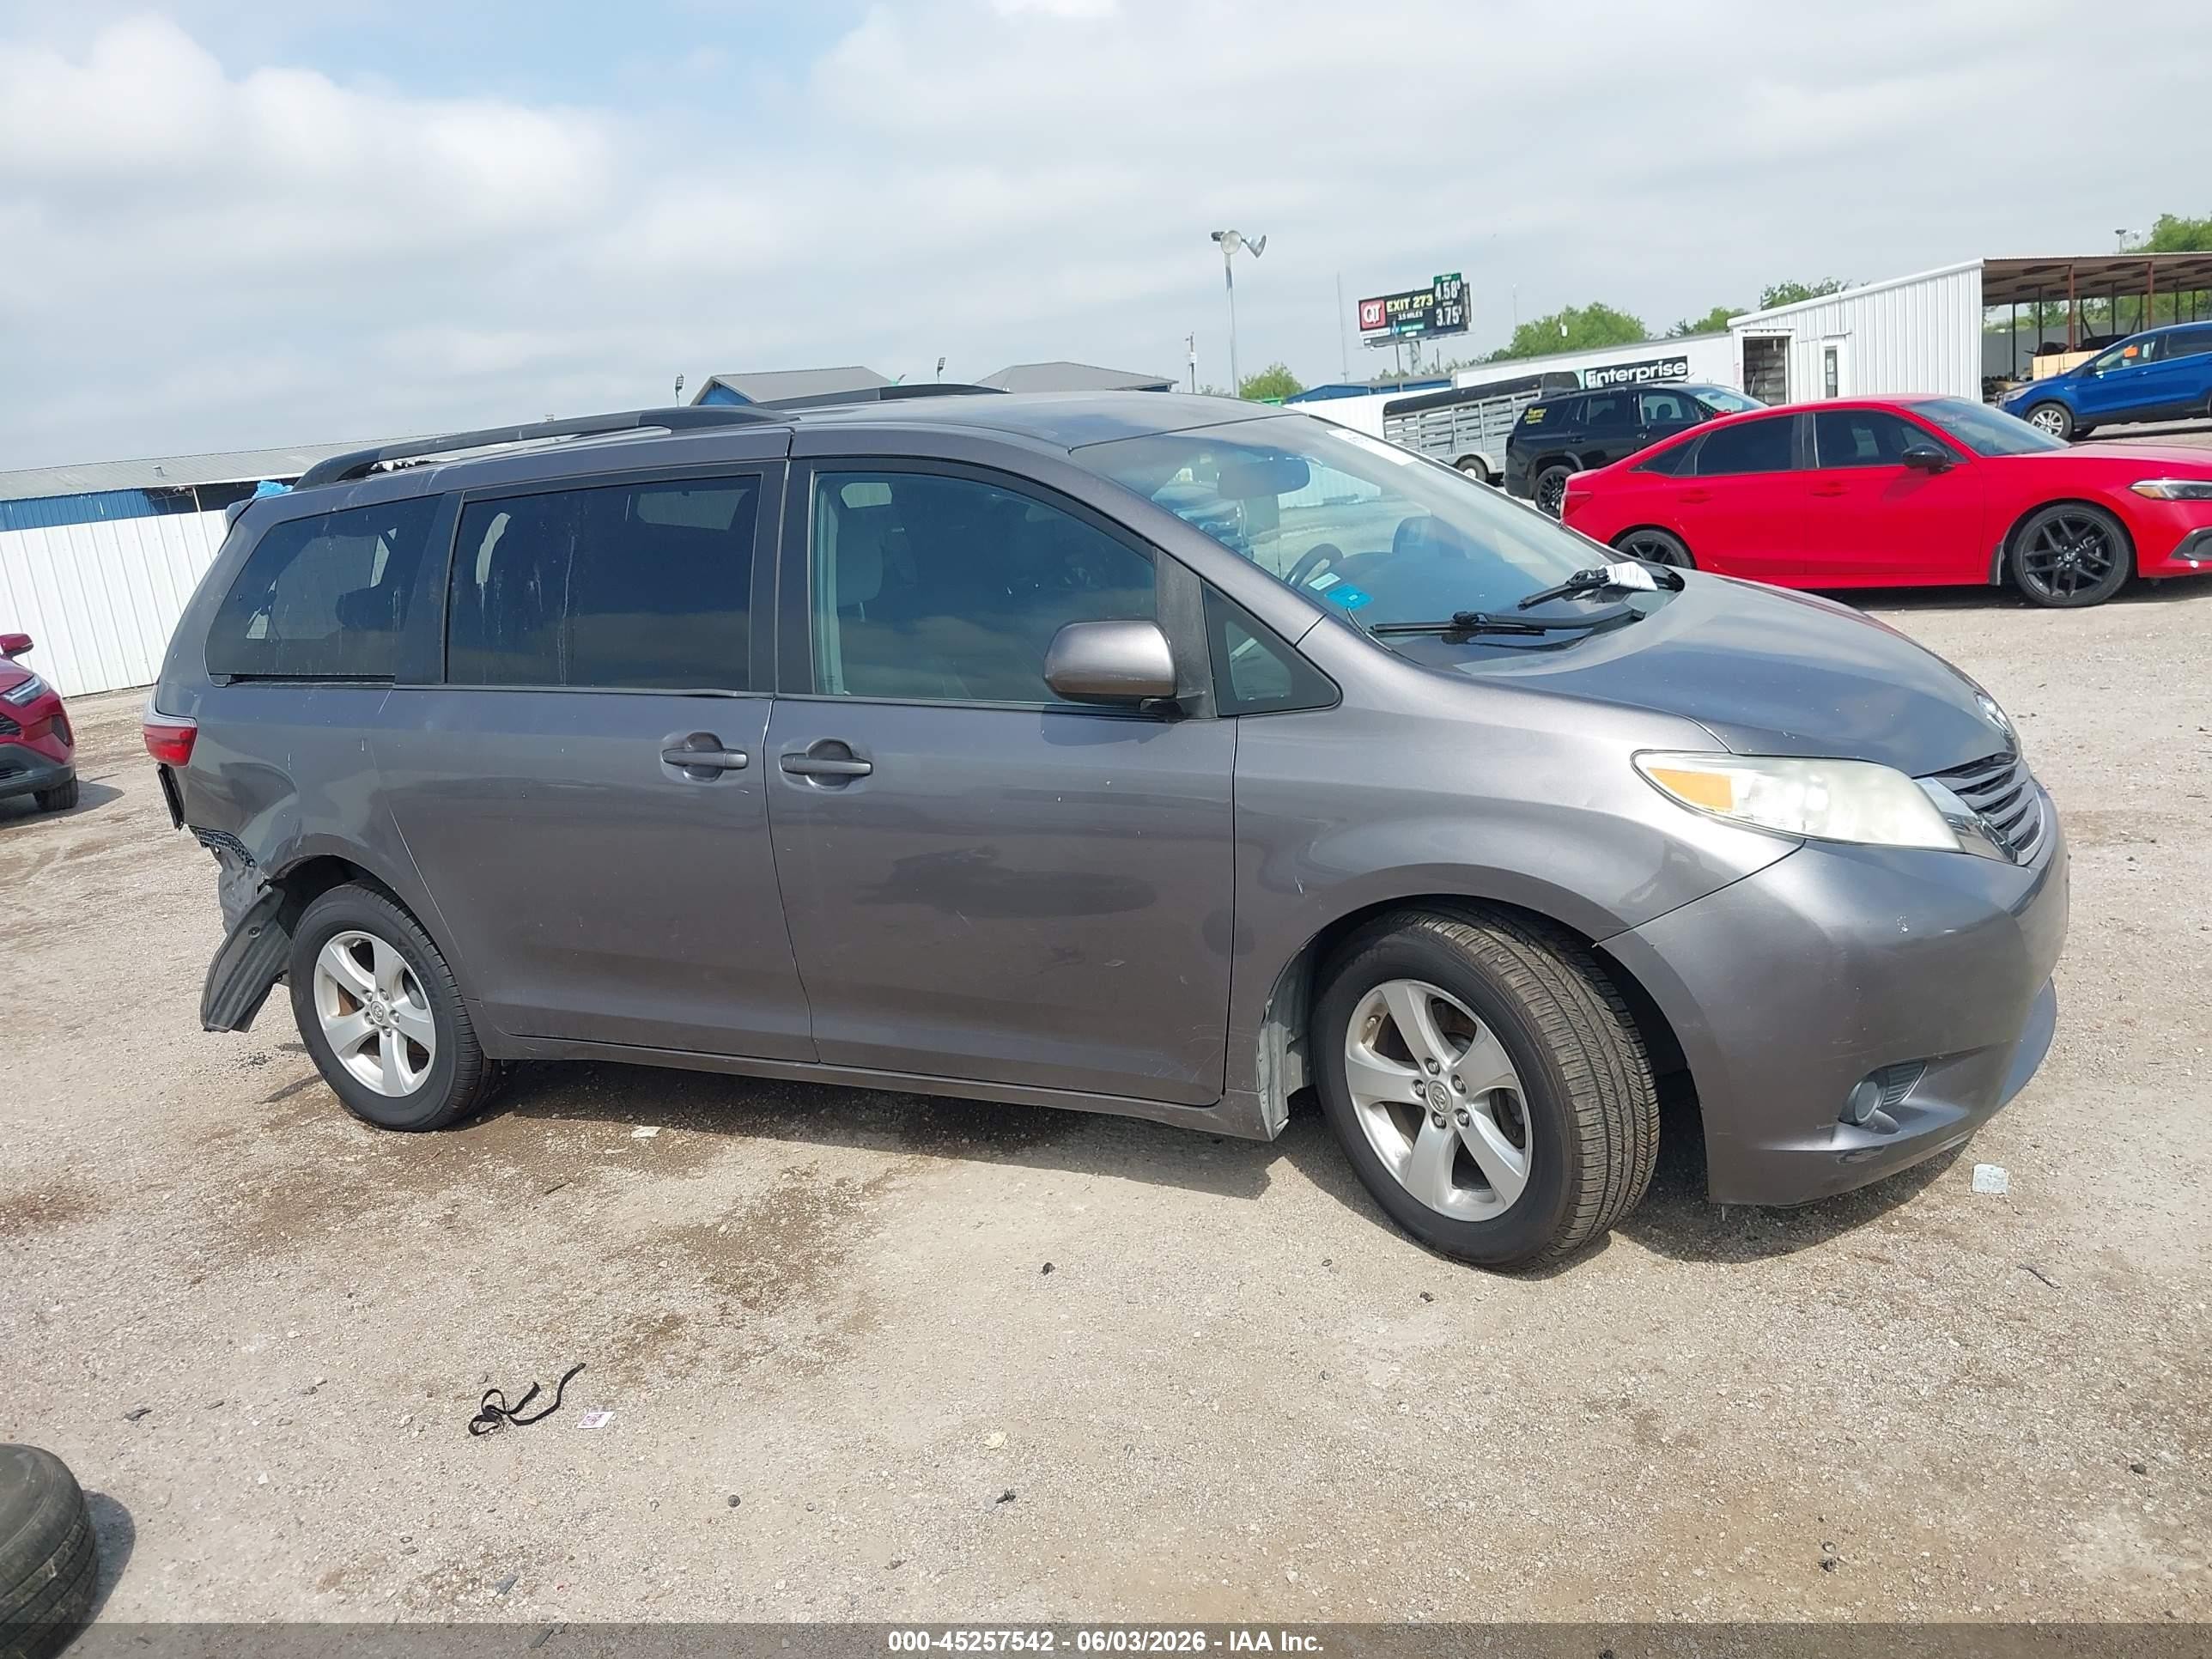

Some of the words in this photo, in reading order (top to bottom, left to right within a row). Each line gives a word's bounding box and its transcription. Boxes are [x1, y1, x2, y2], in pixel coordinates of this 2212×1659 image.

[1386, 300, 1411, 313] EXIT
[1413, 294, 1433, 308] 273
[1364, 305, 1382, 324] QT
[1585, 361, 1687, 388] Enterprise
